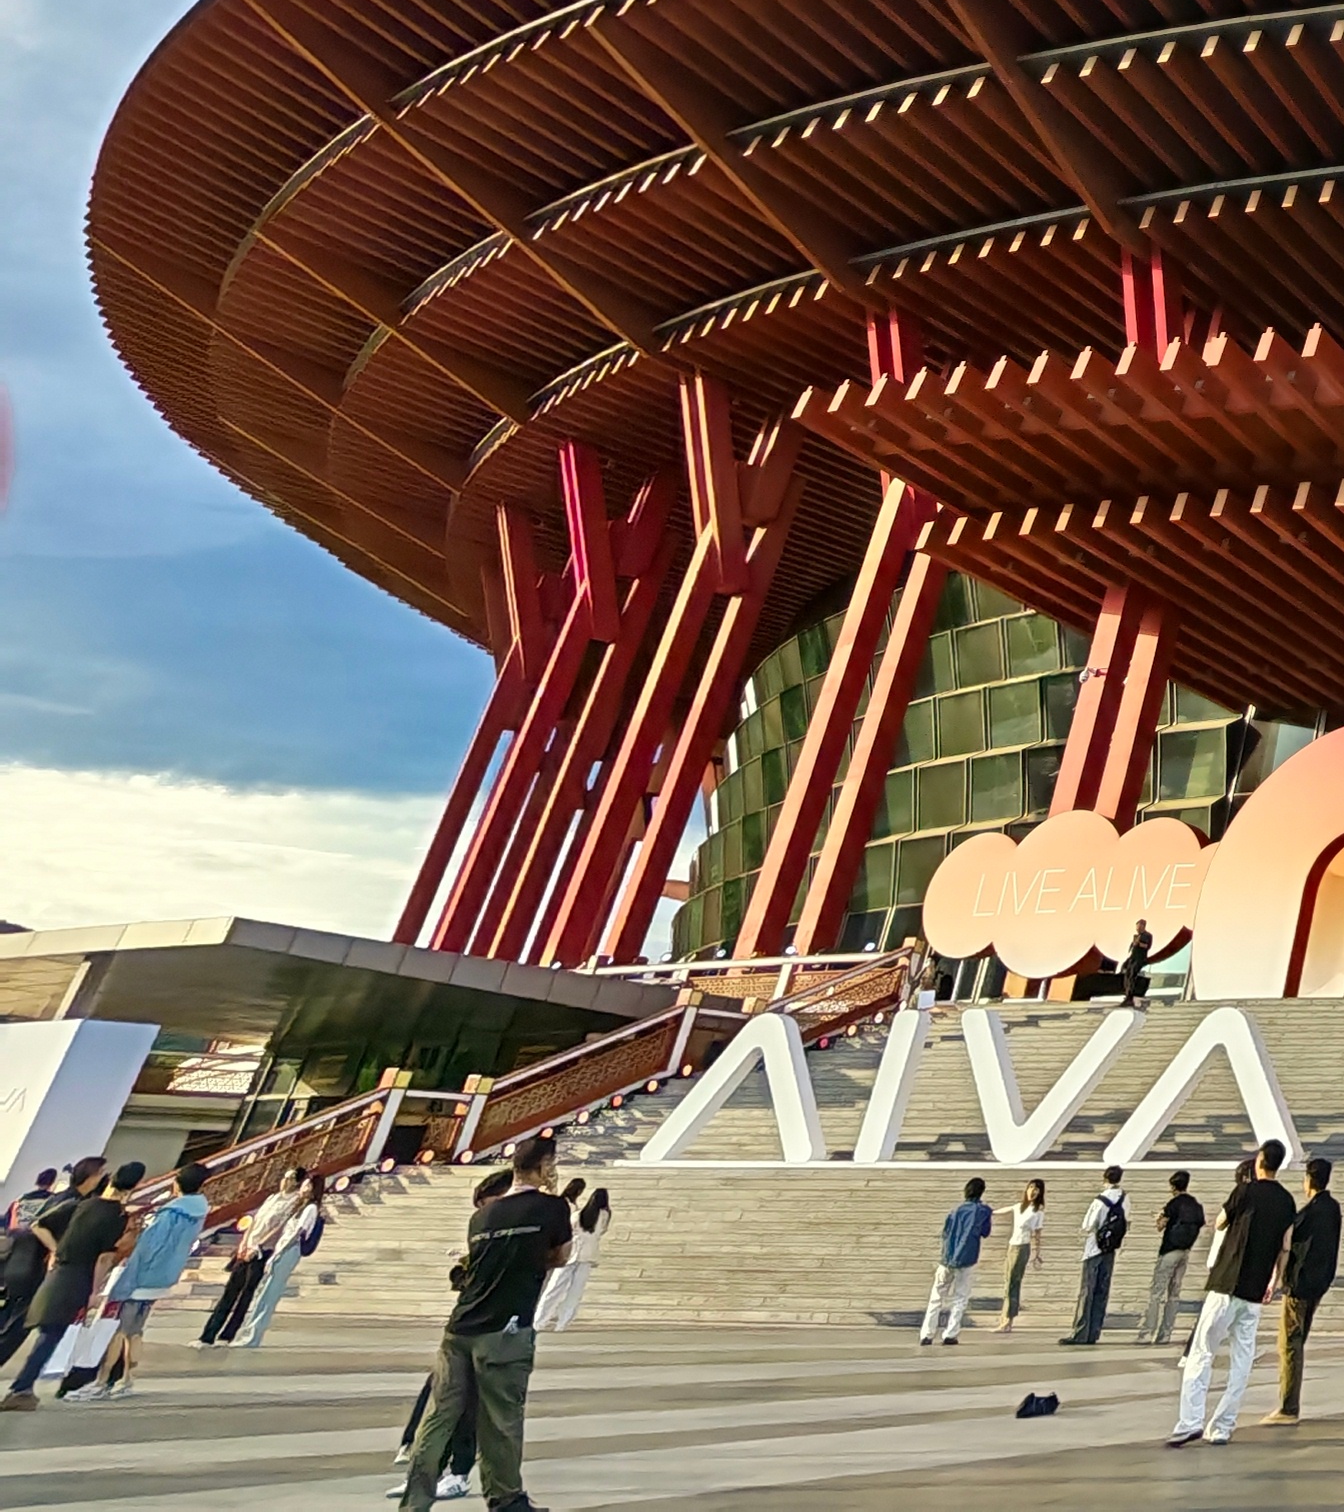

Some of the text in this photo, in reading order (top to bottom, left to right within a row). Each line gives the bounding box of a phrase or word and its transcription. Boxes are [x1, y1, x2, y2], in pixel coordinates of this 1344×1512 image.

[972, 863, 1197, 917] LIVE ALIVE
[639, 1007, 1300, 1168] AIVA
